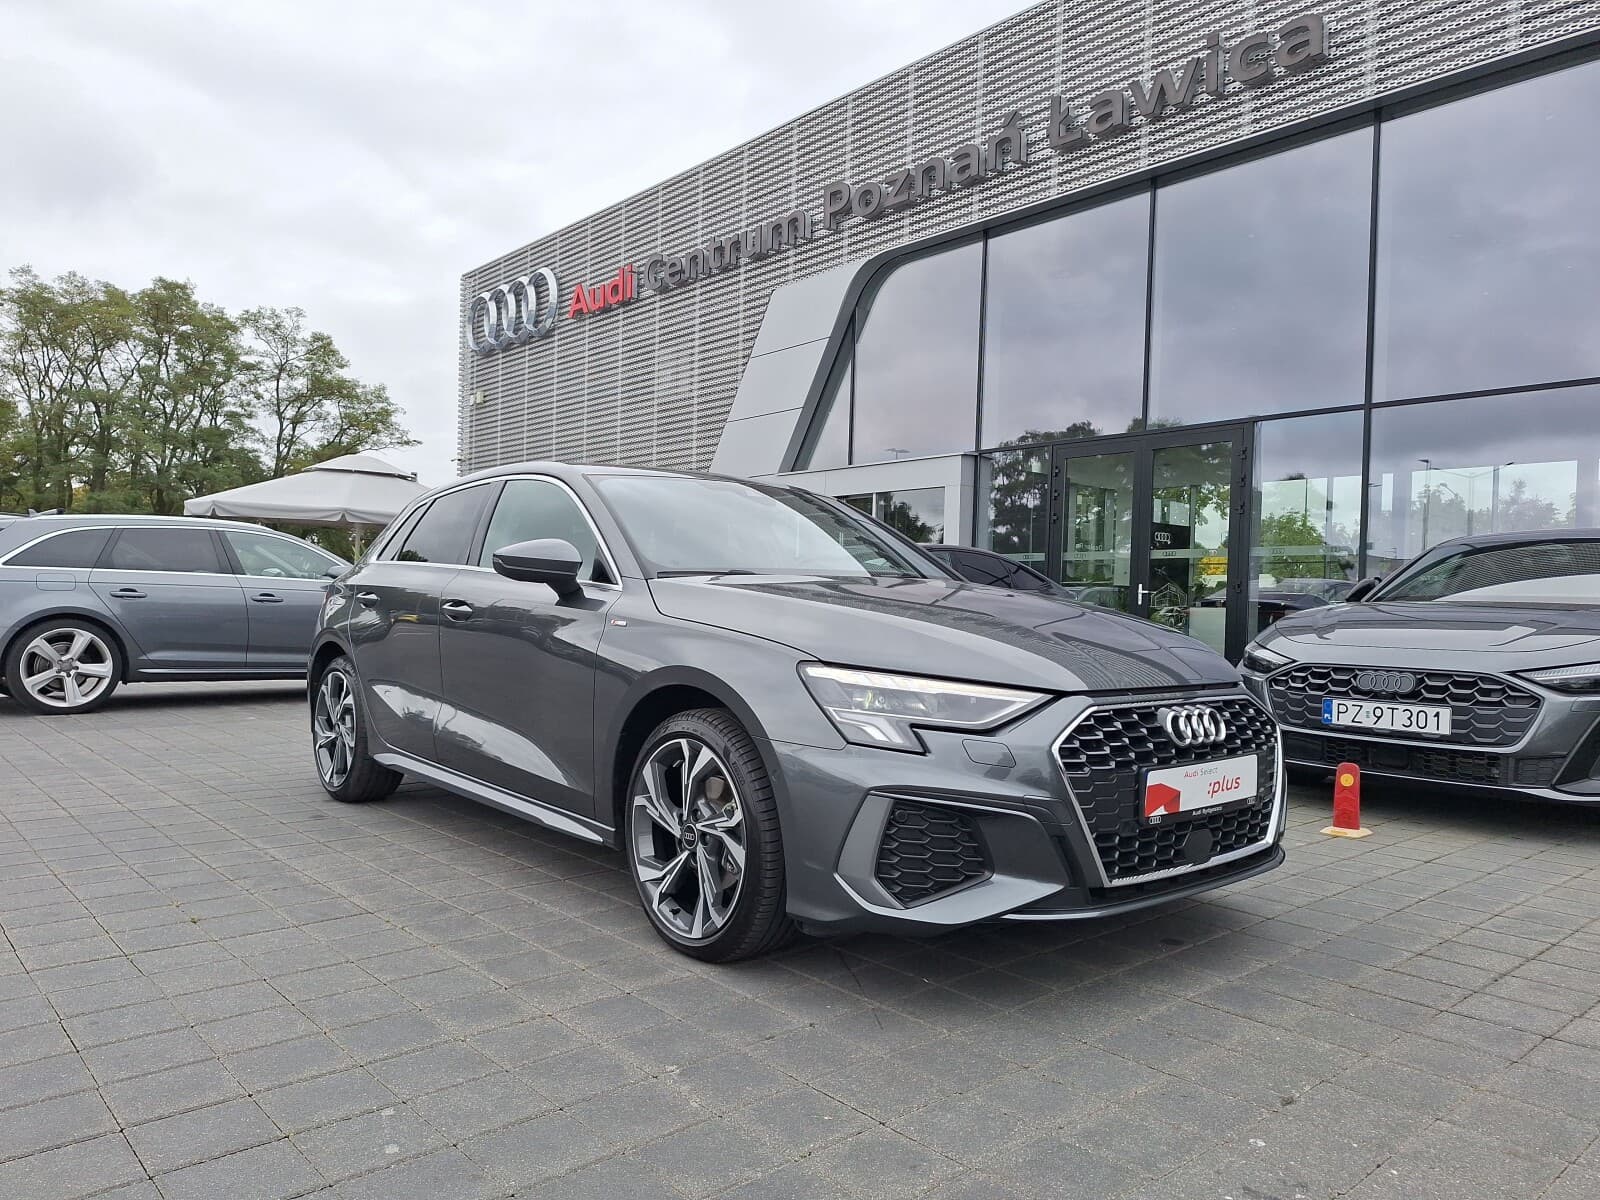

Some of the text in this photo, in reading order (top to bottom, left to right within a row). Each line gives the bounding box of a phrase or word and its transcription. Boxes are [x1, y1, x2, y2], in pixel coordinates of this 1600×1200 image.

[568, 12, 1328, 318] Audi Centrum Poznań Ławica
[1336, 703, 1441, 731] PZ 9T301
[1207, 775, 1241, 798] :plus
